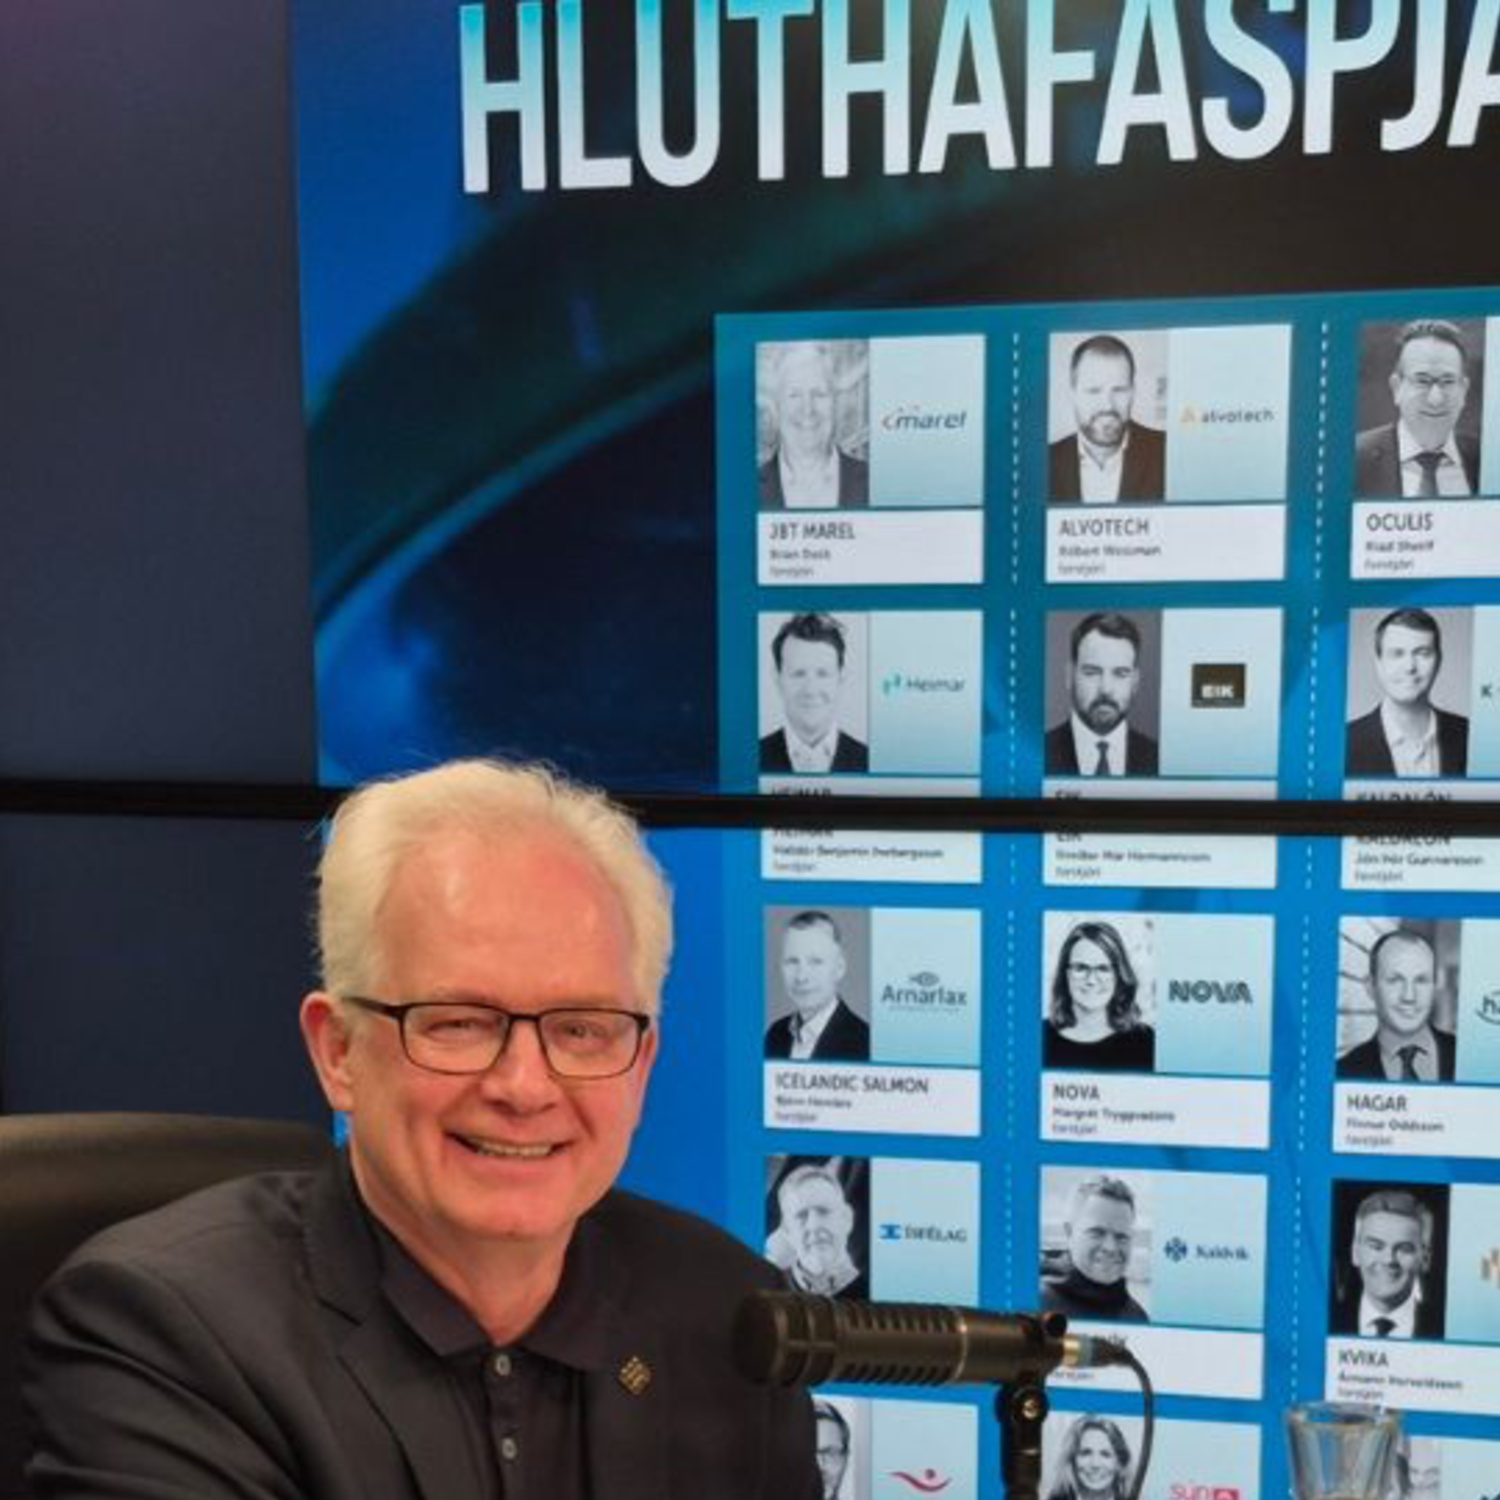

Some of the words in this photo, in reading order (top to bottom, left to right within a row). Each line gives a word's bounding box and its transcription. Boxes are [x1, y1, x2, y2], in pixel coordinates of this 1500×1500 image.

[769, 522, 798, 540] JBT
[802, 521, 856, 540] MAREL
[1059, 518, 1150, 537] ALVOTECH
[1366, 513, 1433, 531] OCULIS
[1202, 684, 1234, 699] EIK
[881, 985, 968, 1006] Arnarlax
[1168, 980, 1253, 1004] NOVA
[776, 1072, 859, 1091] ICELANDIC
[862, 1075, 929, 1094] SALMON
[1052, 1084, 1101, 1101] NOVA
[1346, 1093, 1408, 1112] HAGAR
[1338, 1349, 1389, 1368] KVIKA
